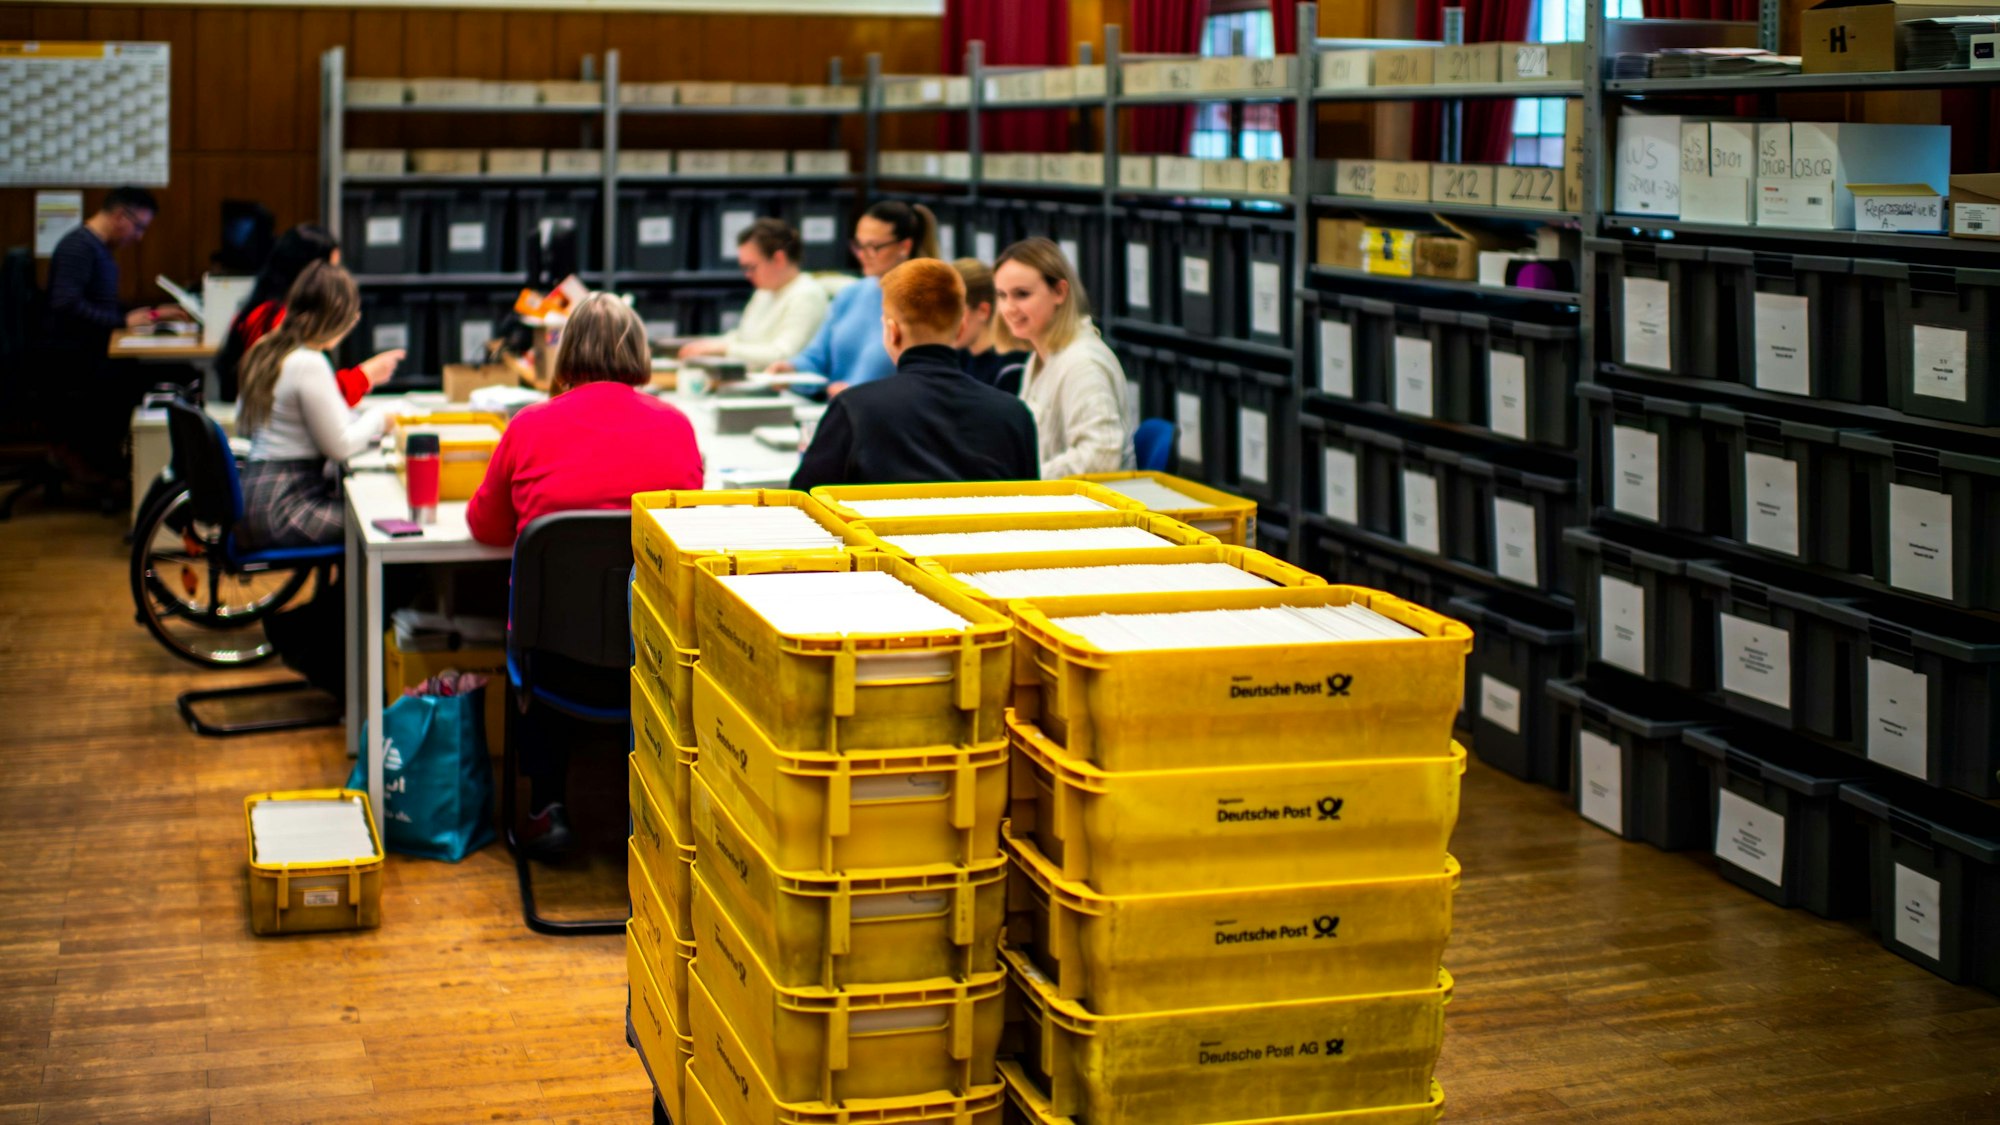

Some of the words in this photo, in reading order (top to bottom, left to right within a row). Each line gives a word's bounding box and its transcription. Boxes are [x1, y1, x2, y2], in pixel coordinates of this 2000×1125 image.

[1445, 168, 1480, 199] 212
[1511, 169, 1554, 201] 222
[1230, 682, 1291, 698] Deutsche
[1294, 681, 1322, 695] Post
[1217, 806, 1280, 823] Deutsche
[1283, 805, 1312, 819] Post
[1215, 926, 1277, 945] Deutsche
[1280, 924, 1308, 939] Post
[1199, 1048, 1262, 1064] Deutsche
[1265, 1045, 1294, 1058] Post
[1299, 1041, 1319, 1055] AG
